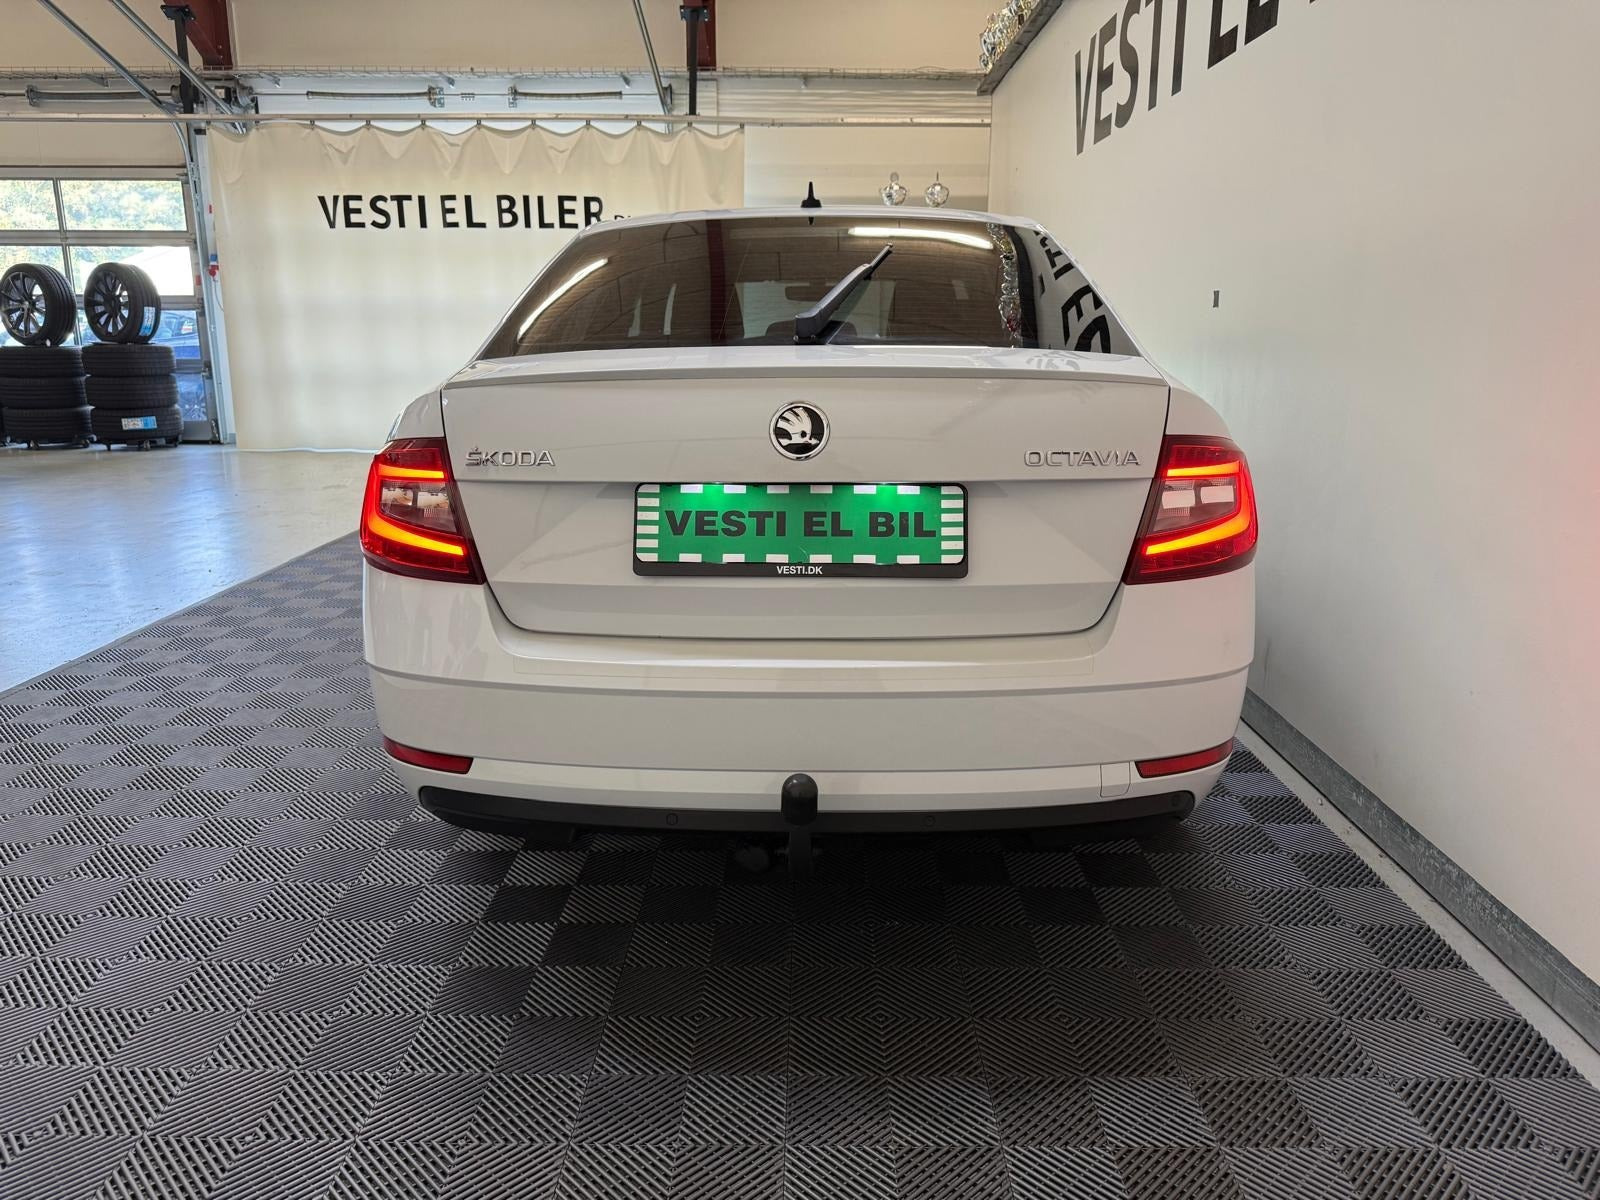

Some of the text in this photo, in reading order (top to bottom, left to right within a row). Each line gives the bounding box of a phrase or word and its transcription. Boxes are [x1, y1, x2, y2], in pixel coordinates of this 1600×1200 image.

[1074, 0, 1188, 156] VESTI
[318, 194, 604, 229] VESTI EL BILER
[465, 447, 555, 467] ŠKODA
[1024, 449, 1141, 467] OCTAVIA
[665, 510, 936, 538] VESTI EL BIL
[776, 565, 823, 575] VESTI.DK
